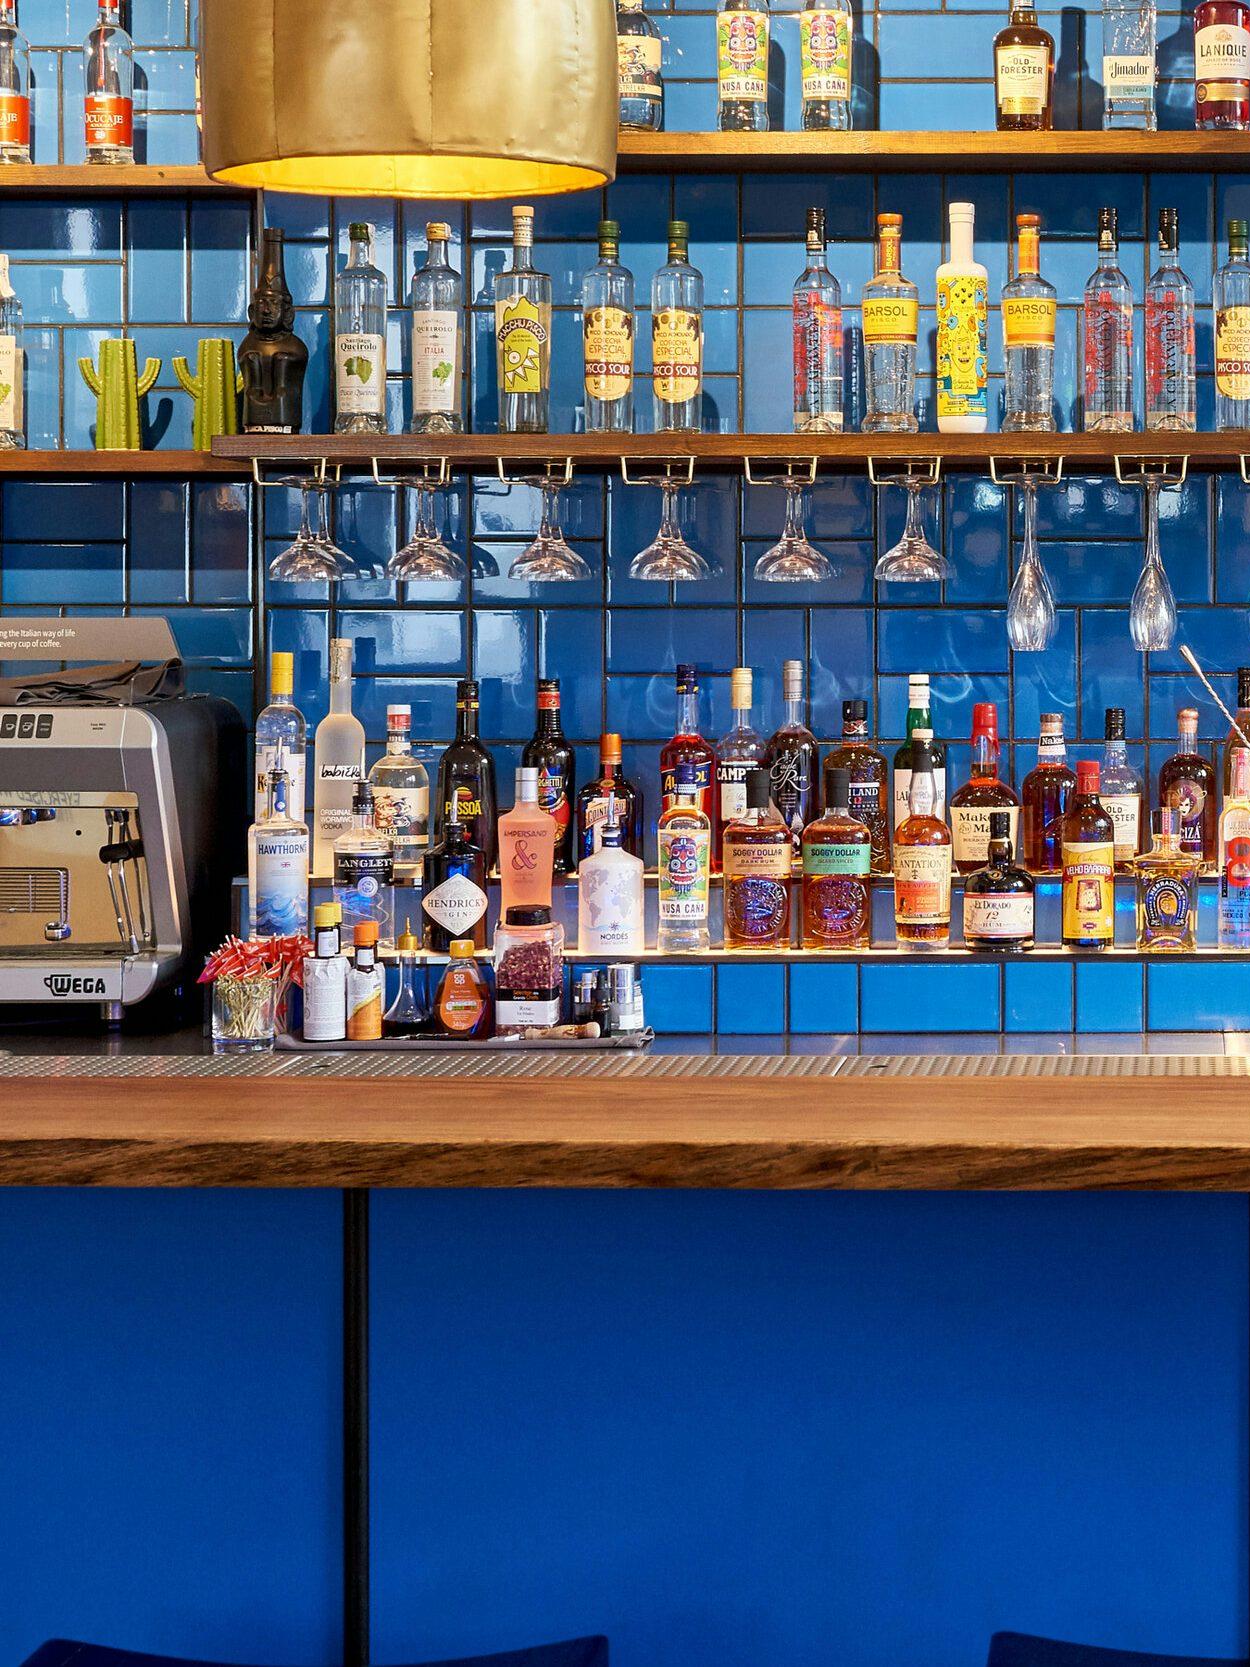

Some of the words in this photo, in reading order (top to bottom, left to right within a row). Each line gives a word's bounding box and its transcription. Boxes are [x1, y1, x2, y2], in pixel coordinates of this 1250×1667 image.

[1200, 44, 1247, 57] LANIQUE
[1013, 58, 1030, 66] OLD
[1001, 65, 1043, 75] FORESTER
[1110, 62, 1149, 78] Jimador
[722, 82, 741, 92] NUSA
[745, 80, 764, 92] CAÑA
[804, 82, 823, 92] NUSA
[827, 80, 846, 92] CAÑA
[864, 306, 907, 317] BARSOL
[1008, 305, 1052, 315] BARSOL
[499, 319, 525, 341] MACCHU
[526, 321, 545, 341] PISCO
[341, 343, 377, 351] Queirolo
[609, 364, 630, 375] SOUR
[676, 365, 698, 376] SOUR
[1218, 362, 1241, 372] PISCO
[321, 808, 352, 816] ORIGINAL
[445, 800, 481, 815] PSSOÃ
[733, 848, 756, 858] SOGGY
[757, 848, 783, 857] DOLLAR
[811, 848, 834, 858] SOGGY
[836, 849, 861, 857] DOLLAR
[1150, 880, 1184, 895] HERRADURA
[662, 902, 681, 913] NUSA
[685, 901, 704, 913] CAÑA
[983, 901, 1011, 910] DORADO
[54, 974, 106, 995] WEGA
